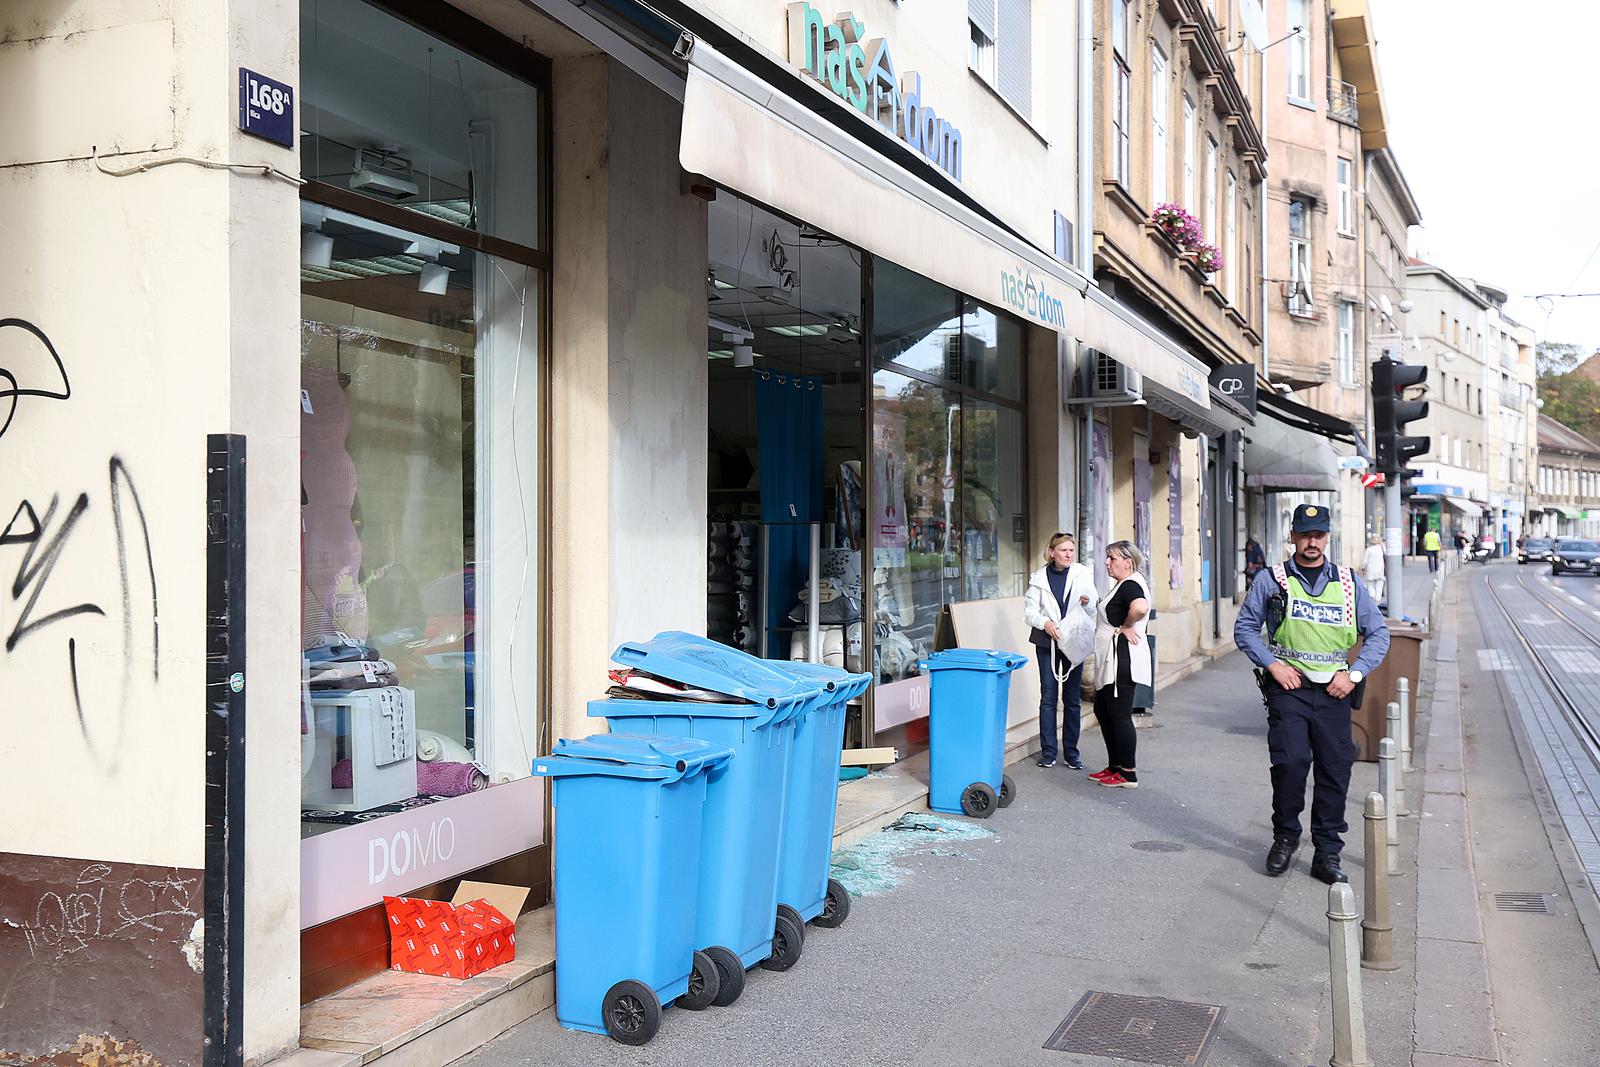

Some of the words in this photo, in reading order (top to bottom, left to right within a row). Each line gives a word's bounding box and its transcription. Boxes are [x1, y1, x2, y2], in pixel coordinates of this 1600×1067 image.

[802, 2, 867, 114] naš
[904, 70, 962, 183] dom
[1001, 265, 1025, 311] naš
[1039, 280, 1065, 328] dom
[368, 817, 454, 885] DOMO
